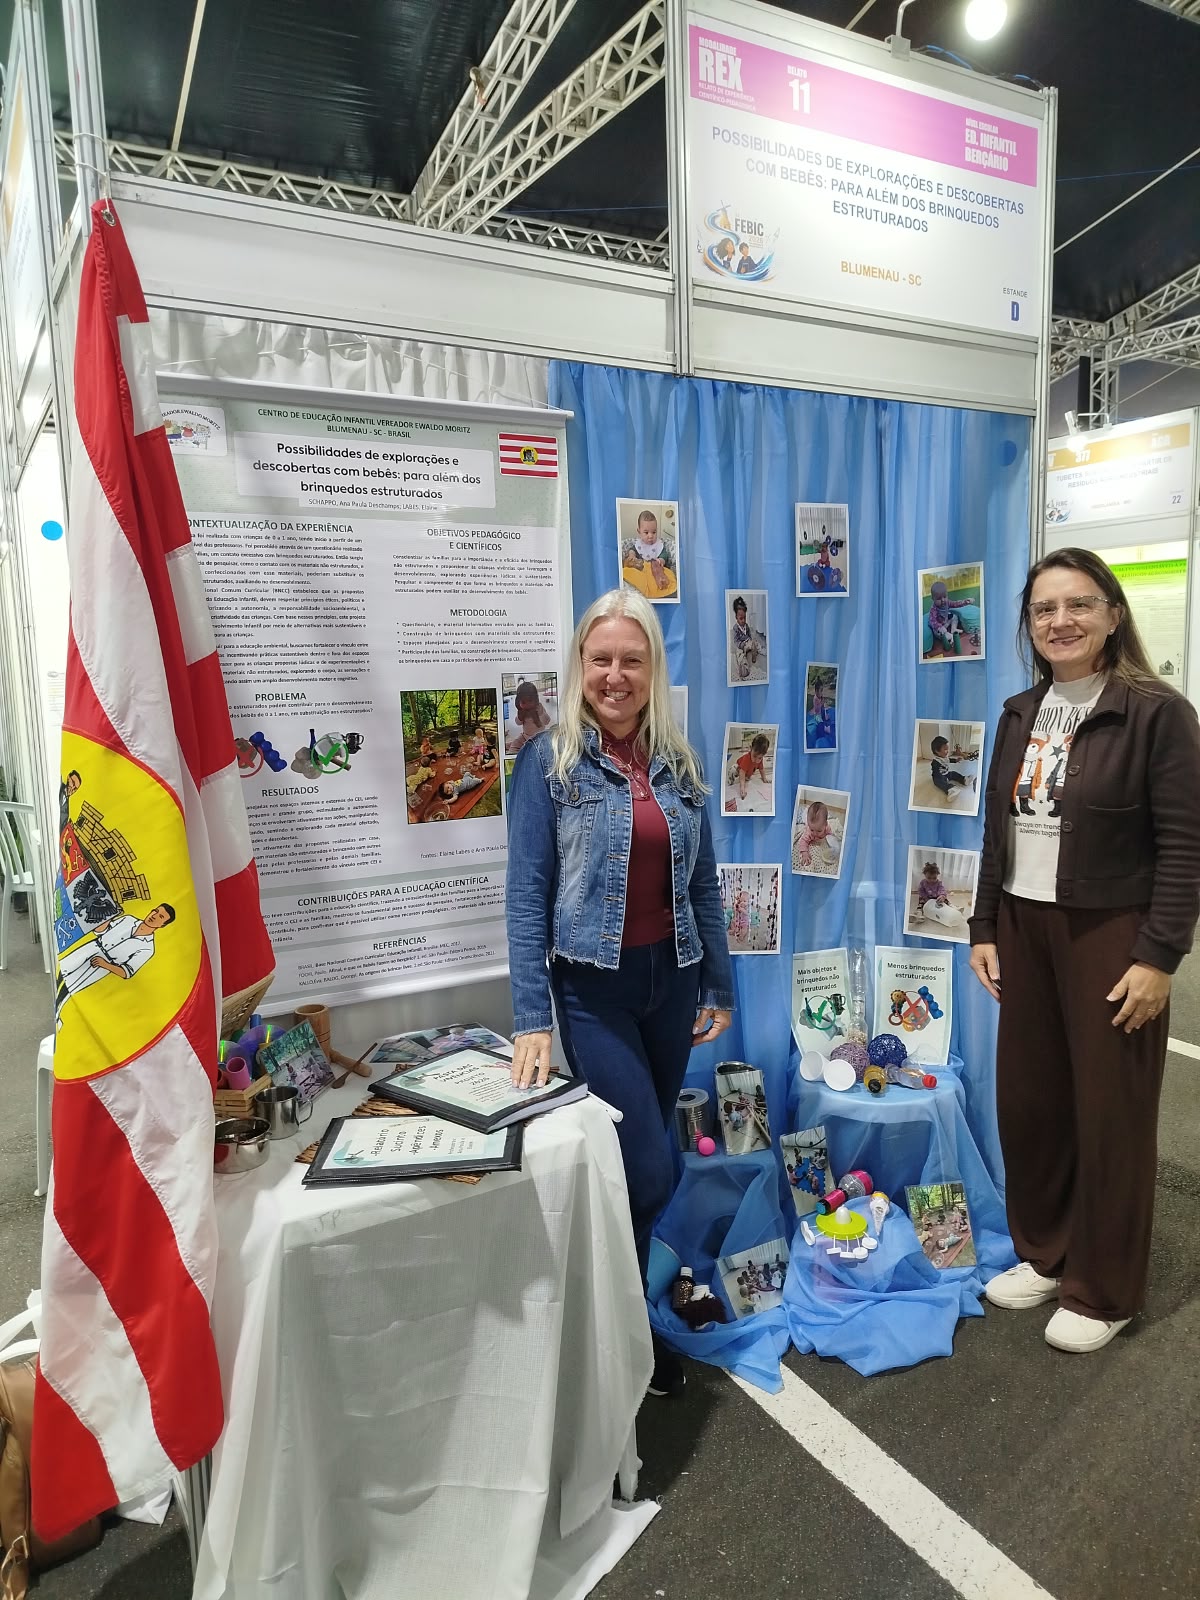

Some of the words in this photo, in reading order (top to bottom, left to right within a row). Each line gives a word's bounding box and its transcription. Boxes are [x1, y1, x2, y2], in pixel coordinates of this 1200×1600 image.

[698, 36, 736, 56] MODALIDADE
[698, 46, 743, 92] REX
[787, 65, 808, 79] RELATO
[698, 82, 716, 92] RELATO
[718, 86, 724, 94] DE
[789, 78, 811, 114] 11
[966, 128, 978, 146] ED.
[980, 132, 1017, 156] INFANTIL
[964, 146, 1009, 172] BERÇÁRIO
[712, 126, 822, 166] POSSIBILIDADES
[826, 155, 842, 171] DE
[846, 158, 933, 195] EXPLORAÇÕES
[937, 182, 944, 196] E
[947, 184, 1024, 215] DESCOBERTAS
[746, 158, 776, 179] COM
[780, 161, 828, 190] BEBÊS:
[831, 177, 863, 200] PARA
[866, 182, 899, 206] ALÉM
[902, 194, 926, 212] DOS
[929, 200, 1000, 230] BRINQUEDOS
[833, 200, 928, 233] ESTRUTURADOS
[734, 218, 764, 237] FEBIC
[841, 260, 900, 284] BLUMENAU
[908, 272, 922, 287] SC
[1002, 287, 1028, 298] ESTANDE
[1010, 301, 1020, 322] D
[202, 415, 220, 430] MORITZ
[258, 408, 288, 418] CENTRO
[290, 410, 300, 418] DE
[302, 411, 342, 424] EDUCAÇÃO
[344, 416, 376, 426] INFANTIL
[377, 419, 414, 429] VEREADOR
[415, 422, 444, 432] EWALDO
[444, 425, 471, 434] MORITZ
[327, 425, 368, 435] BLUMENAU
[388, 430, 412, 438] BRASIL
[277, 442, 362, 459] Possibilidades
[365, 448, 380, 460] de
[382, 452, 450, 467] explorações
[452, 457, 459, 465] e
[253, 460, 331, 475] descobertas
[334, 467, 360, 476] com
[362, 466, 401, 480] bebês:
[403, 472, 430, 482] para
[432, 471, 460, 483] além
[462, 474, 481, 484] dos
[1056, 472, 1082, 482] TUBETES
[300, 481, 368, 496] brinquedos
[370, 488, 442, 500] estruturados
[308, 498, 338, 506] SCHAPPO,
[369, 502, 402, 511] Deschamps;
[1172, 495, 1182, 504] 22
[280, 523, 294, 532] DA
[296, 522, 354, 533] EXPERIÊNCIA
[426, 528, 470, 538] OBJETIVOS
[472, 530, 521, 540] PEDAGÓGICO
[450, 542, 454, 550] E
[456, 540, 502, 551] CIENTÍFICOS
[450, 608, 508, 617] METODOLOGIA
[255, 692, 306, 702] PROBLEMA
[262, 786, 319, 797] RESULTADOS
[298, 891, 368, 906] CONTRIBUIÇÕES
[370, 888, 392, 898] PARA
[402, 880, 446, 894] EDUCAÇÃO
[448, 876, 489, 888] CIENTÍFICA
[373, 936, 426, 950] REFERÊNCIAS
[812, 966, 832, 976] objetos
[909, 964, 946, 974] brinquedos
[796, 976, 828, 985] brinquedos
[895, 972, 936, 981] estruturados
[801, 983, 837, 992] estruturados
[390, 1130, 407, 1152] Sucinto
